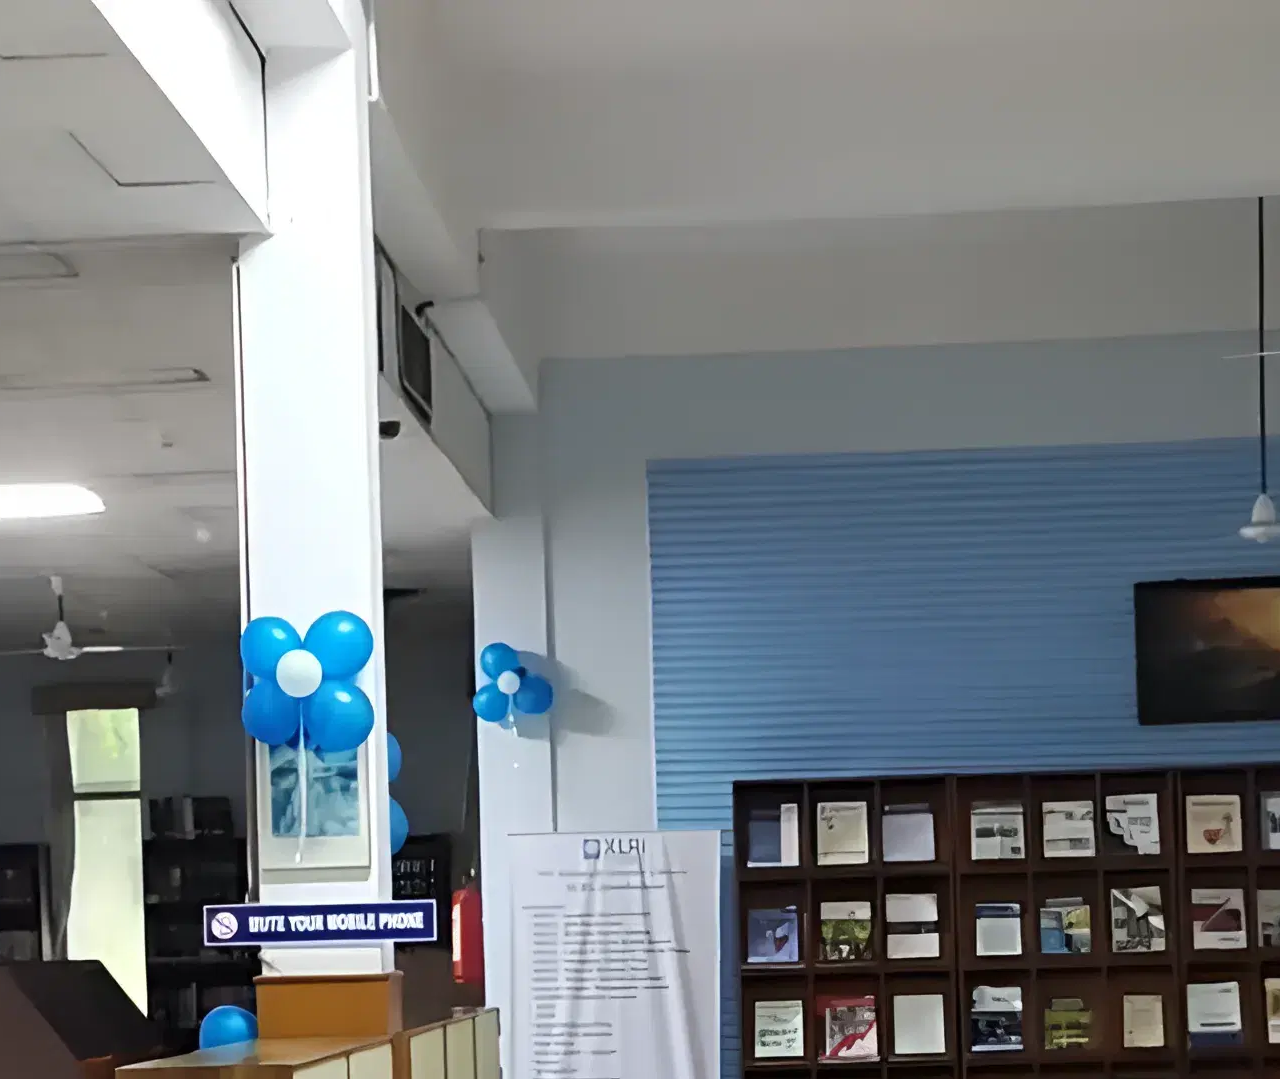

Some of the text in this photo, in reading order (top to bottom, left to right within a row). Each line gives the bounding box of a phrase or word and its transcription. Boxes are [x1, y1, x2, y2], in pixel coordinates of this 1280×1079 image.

[604, 838, 646, 854] XLRI
[248, 911, 424, 933] MUTE YOUR MOBILE PHONE
